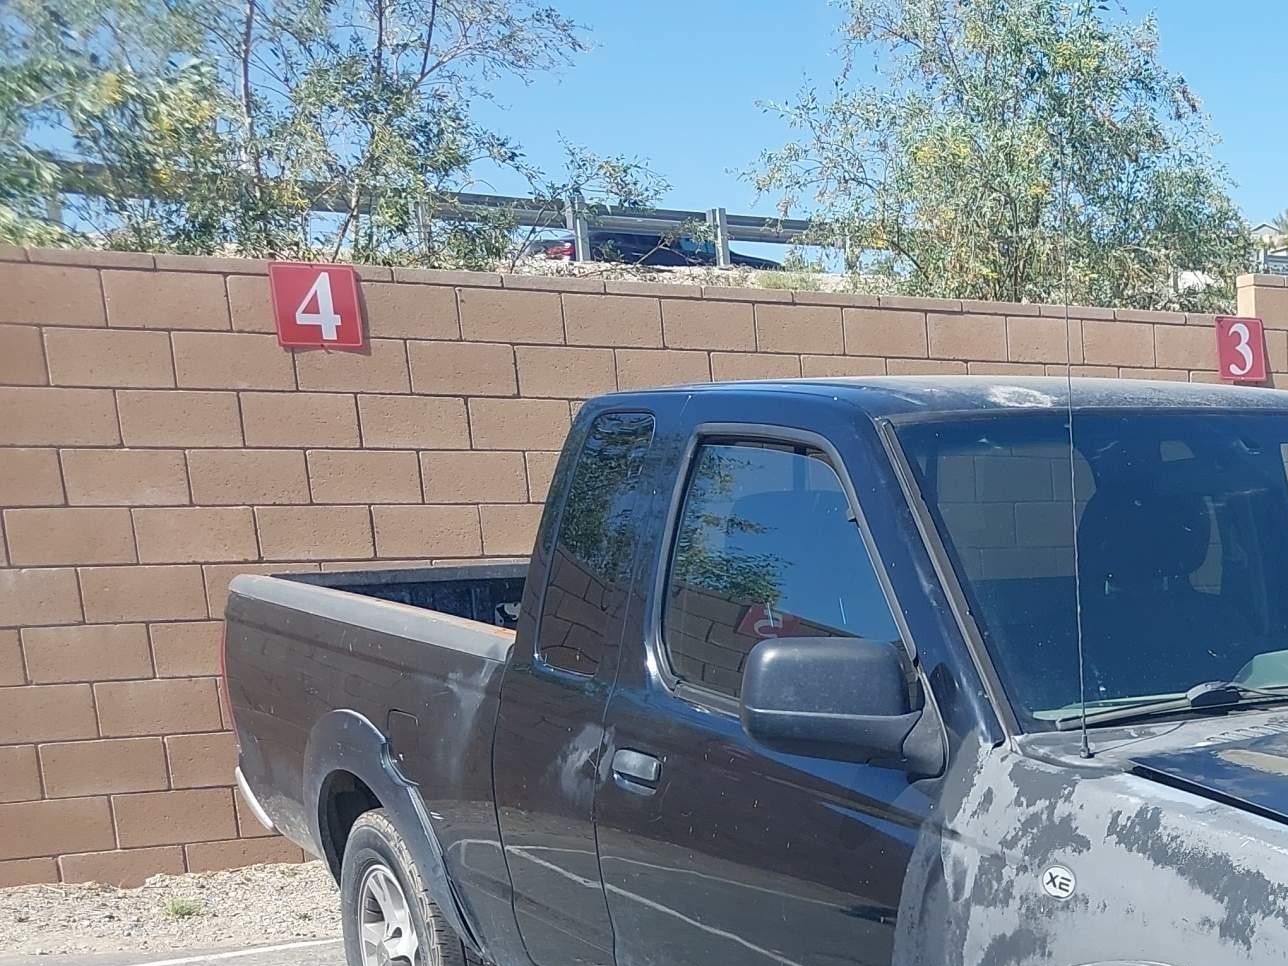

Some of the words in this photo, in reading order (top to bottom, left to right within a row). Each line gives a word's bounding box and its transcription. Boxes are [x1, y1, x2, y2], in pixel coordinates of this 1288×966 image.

[296, 271, 342, 341] 4
[1228, 322, 1253, 376] 3
[1046, 871, 1072, 893] XE
